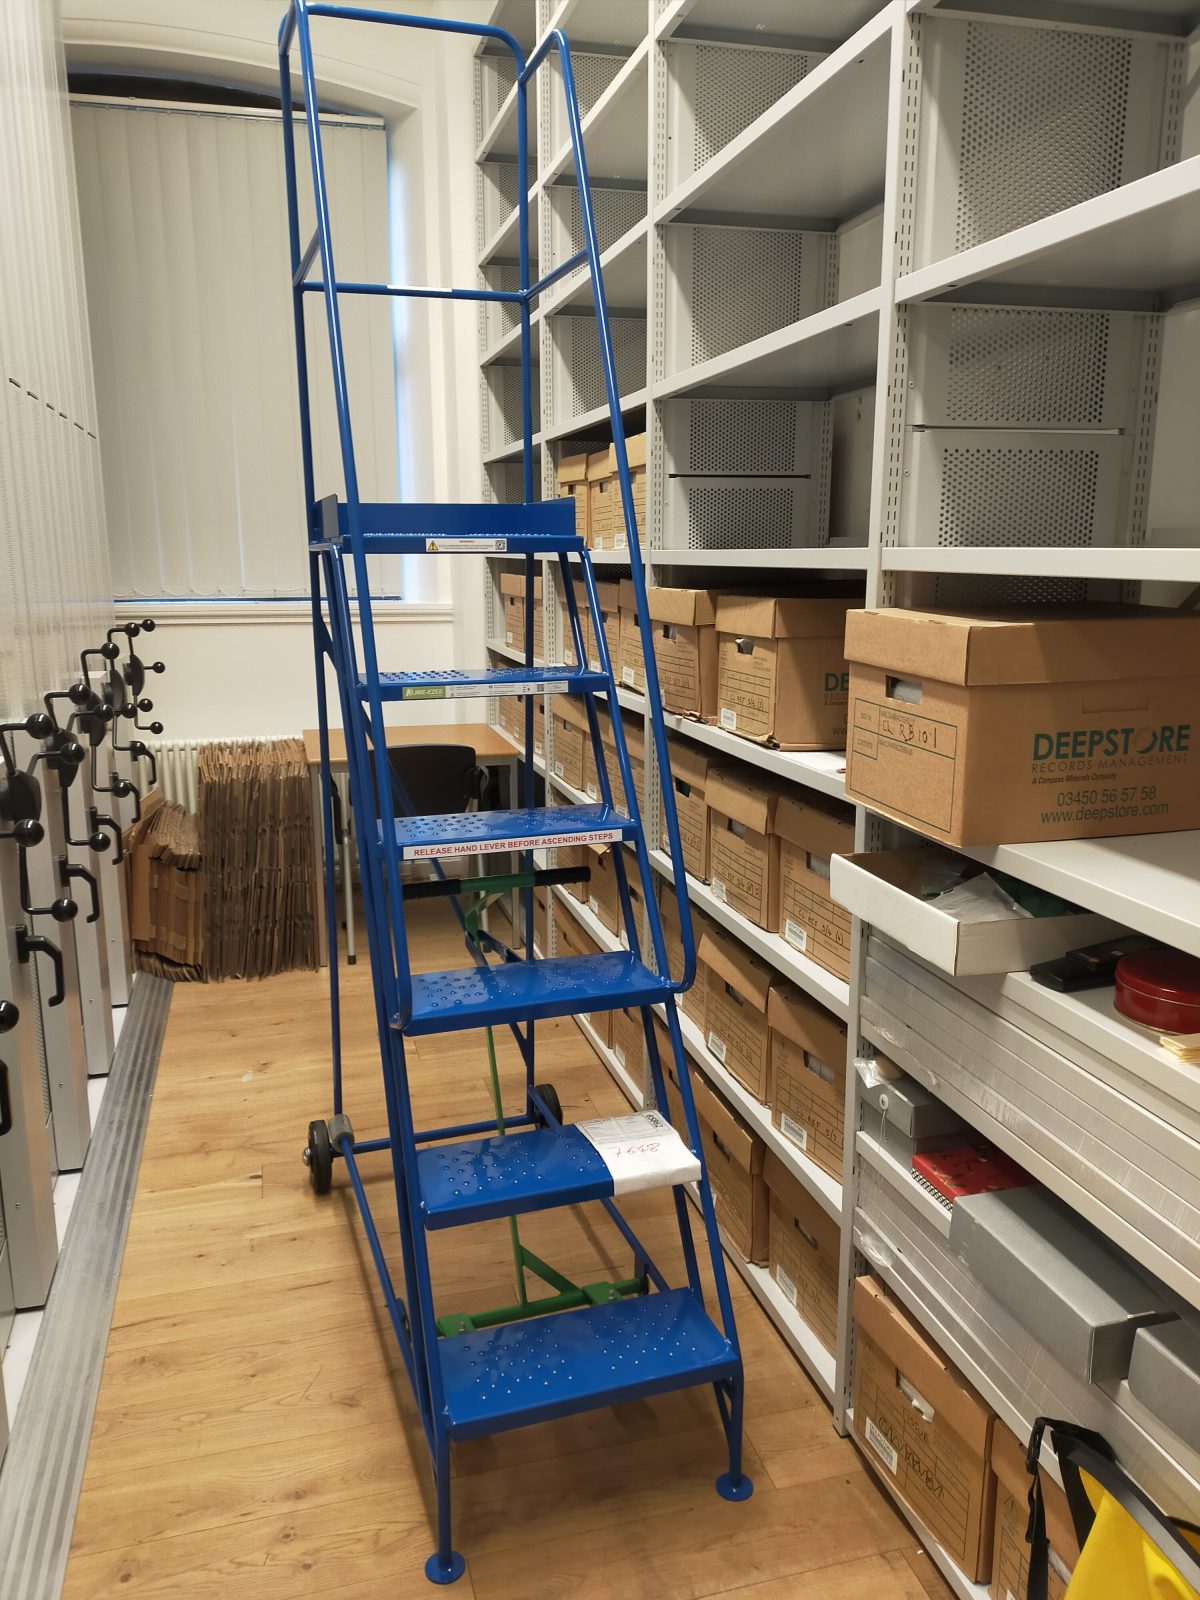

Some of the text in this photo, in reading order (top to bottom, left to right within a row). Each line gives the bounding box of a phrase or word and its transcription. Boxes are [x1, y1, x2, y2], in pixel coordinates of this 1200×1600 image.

[1033, 724, 1191, 761] DEEPSTORE
[1031, 753, 1188, 774] RECORDS MANAGEMENT
[1038, 776, 1065, 785] Compass
[1065, 774, 1090, 782] Minerals
[1091, 772, 1118, 781] Company
[1056, 785, 1157, 807] 03450 56 57 58
[1040, 802, 1169, 823] www.deepstore.com
[413, 832, 613, 857] RELEASE HAND LEVER BEFORE ASCENDING STEPS
